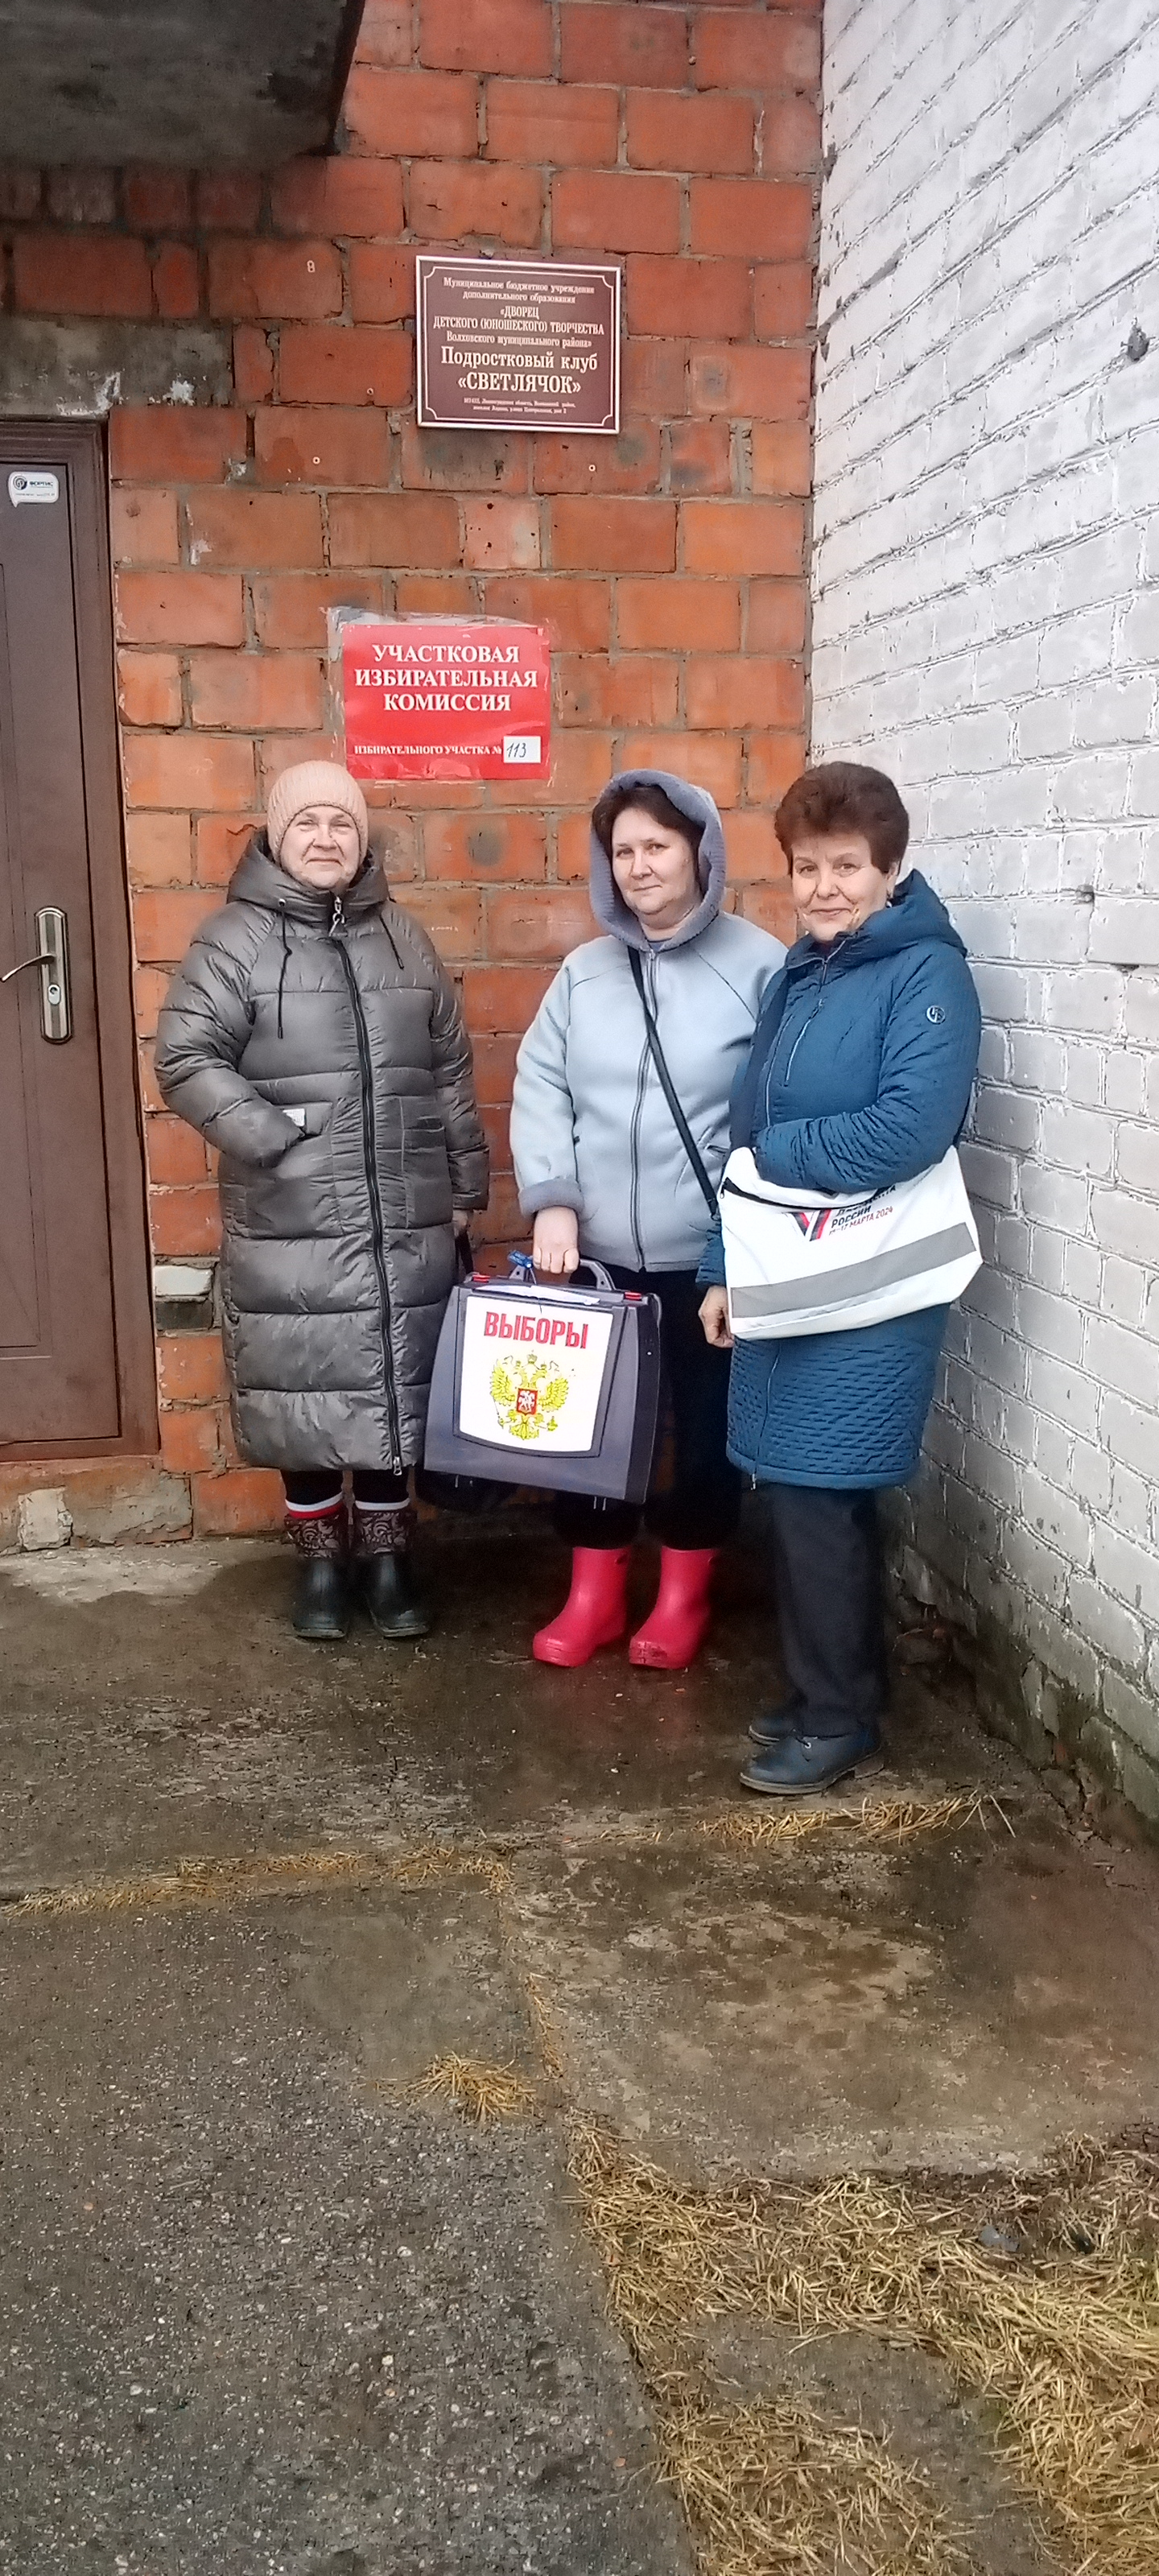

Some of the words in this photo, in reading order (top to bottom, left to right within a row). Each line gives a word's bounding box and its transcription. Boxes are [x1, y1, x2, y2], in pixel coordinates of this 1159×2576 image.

[443, 277, 505, 289] Муниципальное
[506, 280, 548, 291] бюджетное
[551, 284, 595, 294] учреждения
[463, 291, 527, 301] дополнительного
[530, 292, 575, 303] образования
[500, 305, 539, 320] «ДВОРЕЦ
[433, 316, 478, 329] ДЕТСКОГО
[481, 317, 547, 332] (ЮНОШЕСКОГО)
[550, 321, 604, 335] ТВОРЧЕСТВА
[446, 331, 495, 343] Волховского
[497, 335, 560, 347] муниципального
[562, 336, 592, 349] района»
[440, 346, 555, 369] Подростковый
[561, 353, 598, 374] клуб
[457, 372, 582, 394] «СВЕТЛЯЧОК»
[372, 644, 520, 663] УЧАСТКОВАЯ
[354, 669, 538, 688] ИЗБИРАТЕЛЬНАЯ
[383, 693, 511, 712] КОМИССИЯ
[354, 745, 443, 755] ИЗБИРАТЕЛЬНОГО
[444, 745, 490, 756] УЧАСТКА
[506, 742, 527, 758] 113
[831, 1204, 872, 1228] РОССИИ
[849, 1212, 874, 1228] МАРТА
[484, 1311, 589, 1349] ВЫБОРЫ
